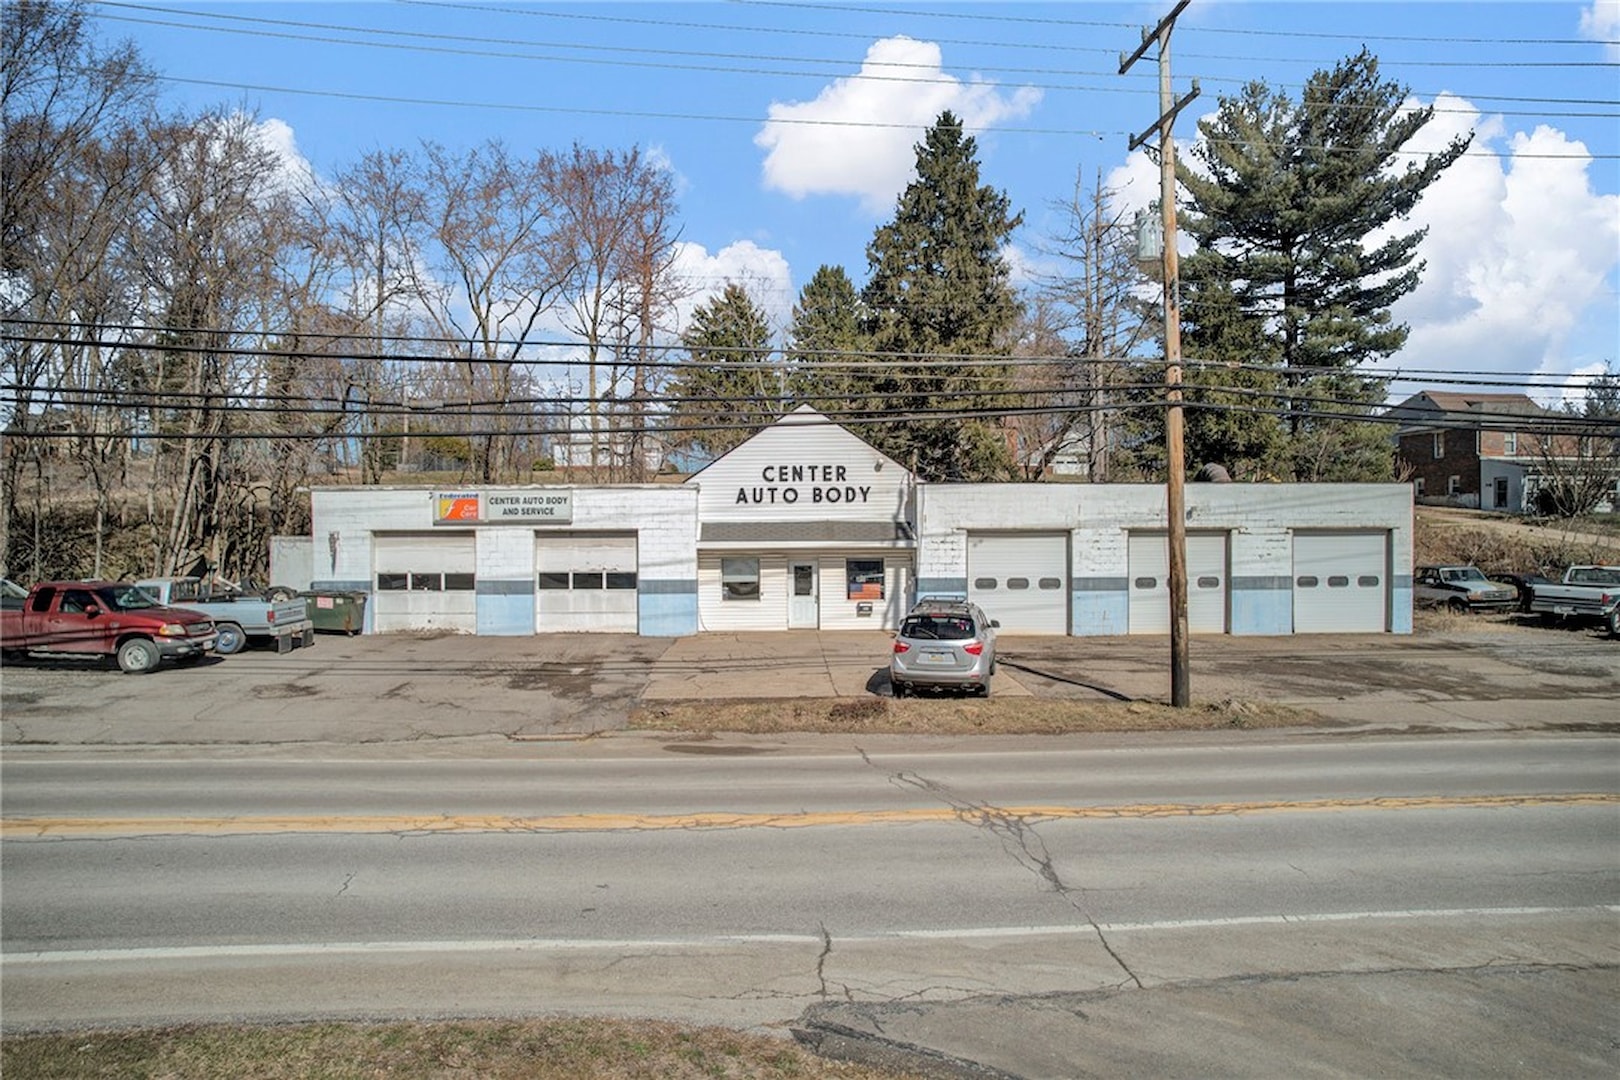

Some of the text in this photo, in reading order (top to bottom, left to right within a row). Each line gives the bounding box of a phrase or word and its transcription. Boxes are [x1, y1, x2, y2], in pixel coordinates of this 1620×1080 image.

[762, 465, 847, 482] CENTER
[488, 496, 569, 505] CENTER AUTO BODY
[735, 486, 871, 504] AUTO BODY
[502, 507, 555, 516] AND SERVICE
